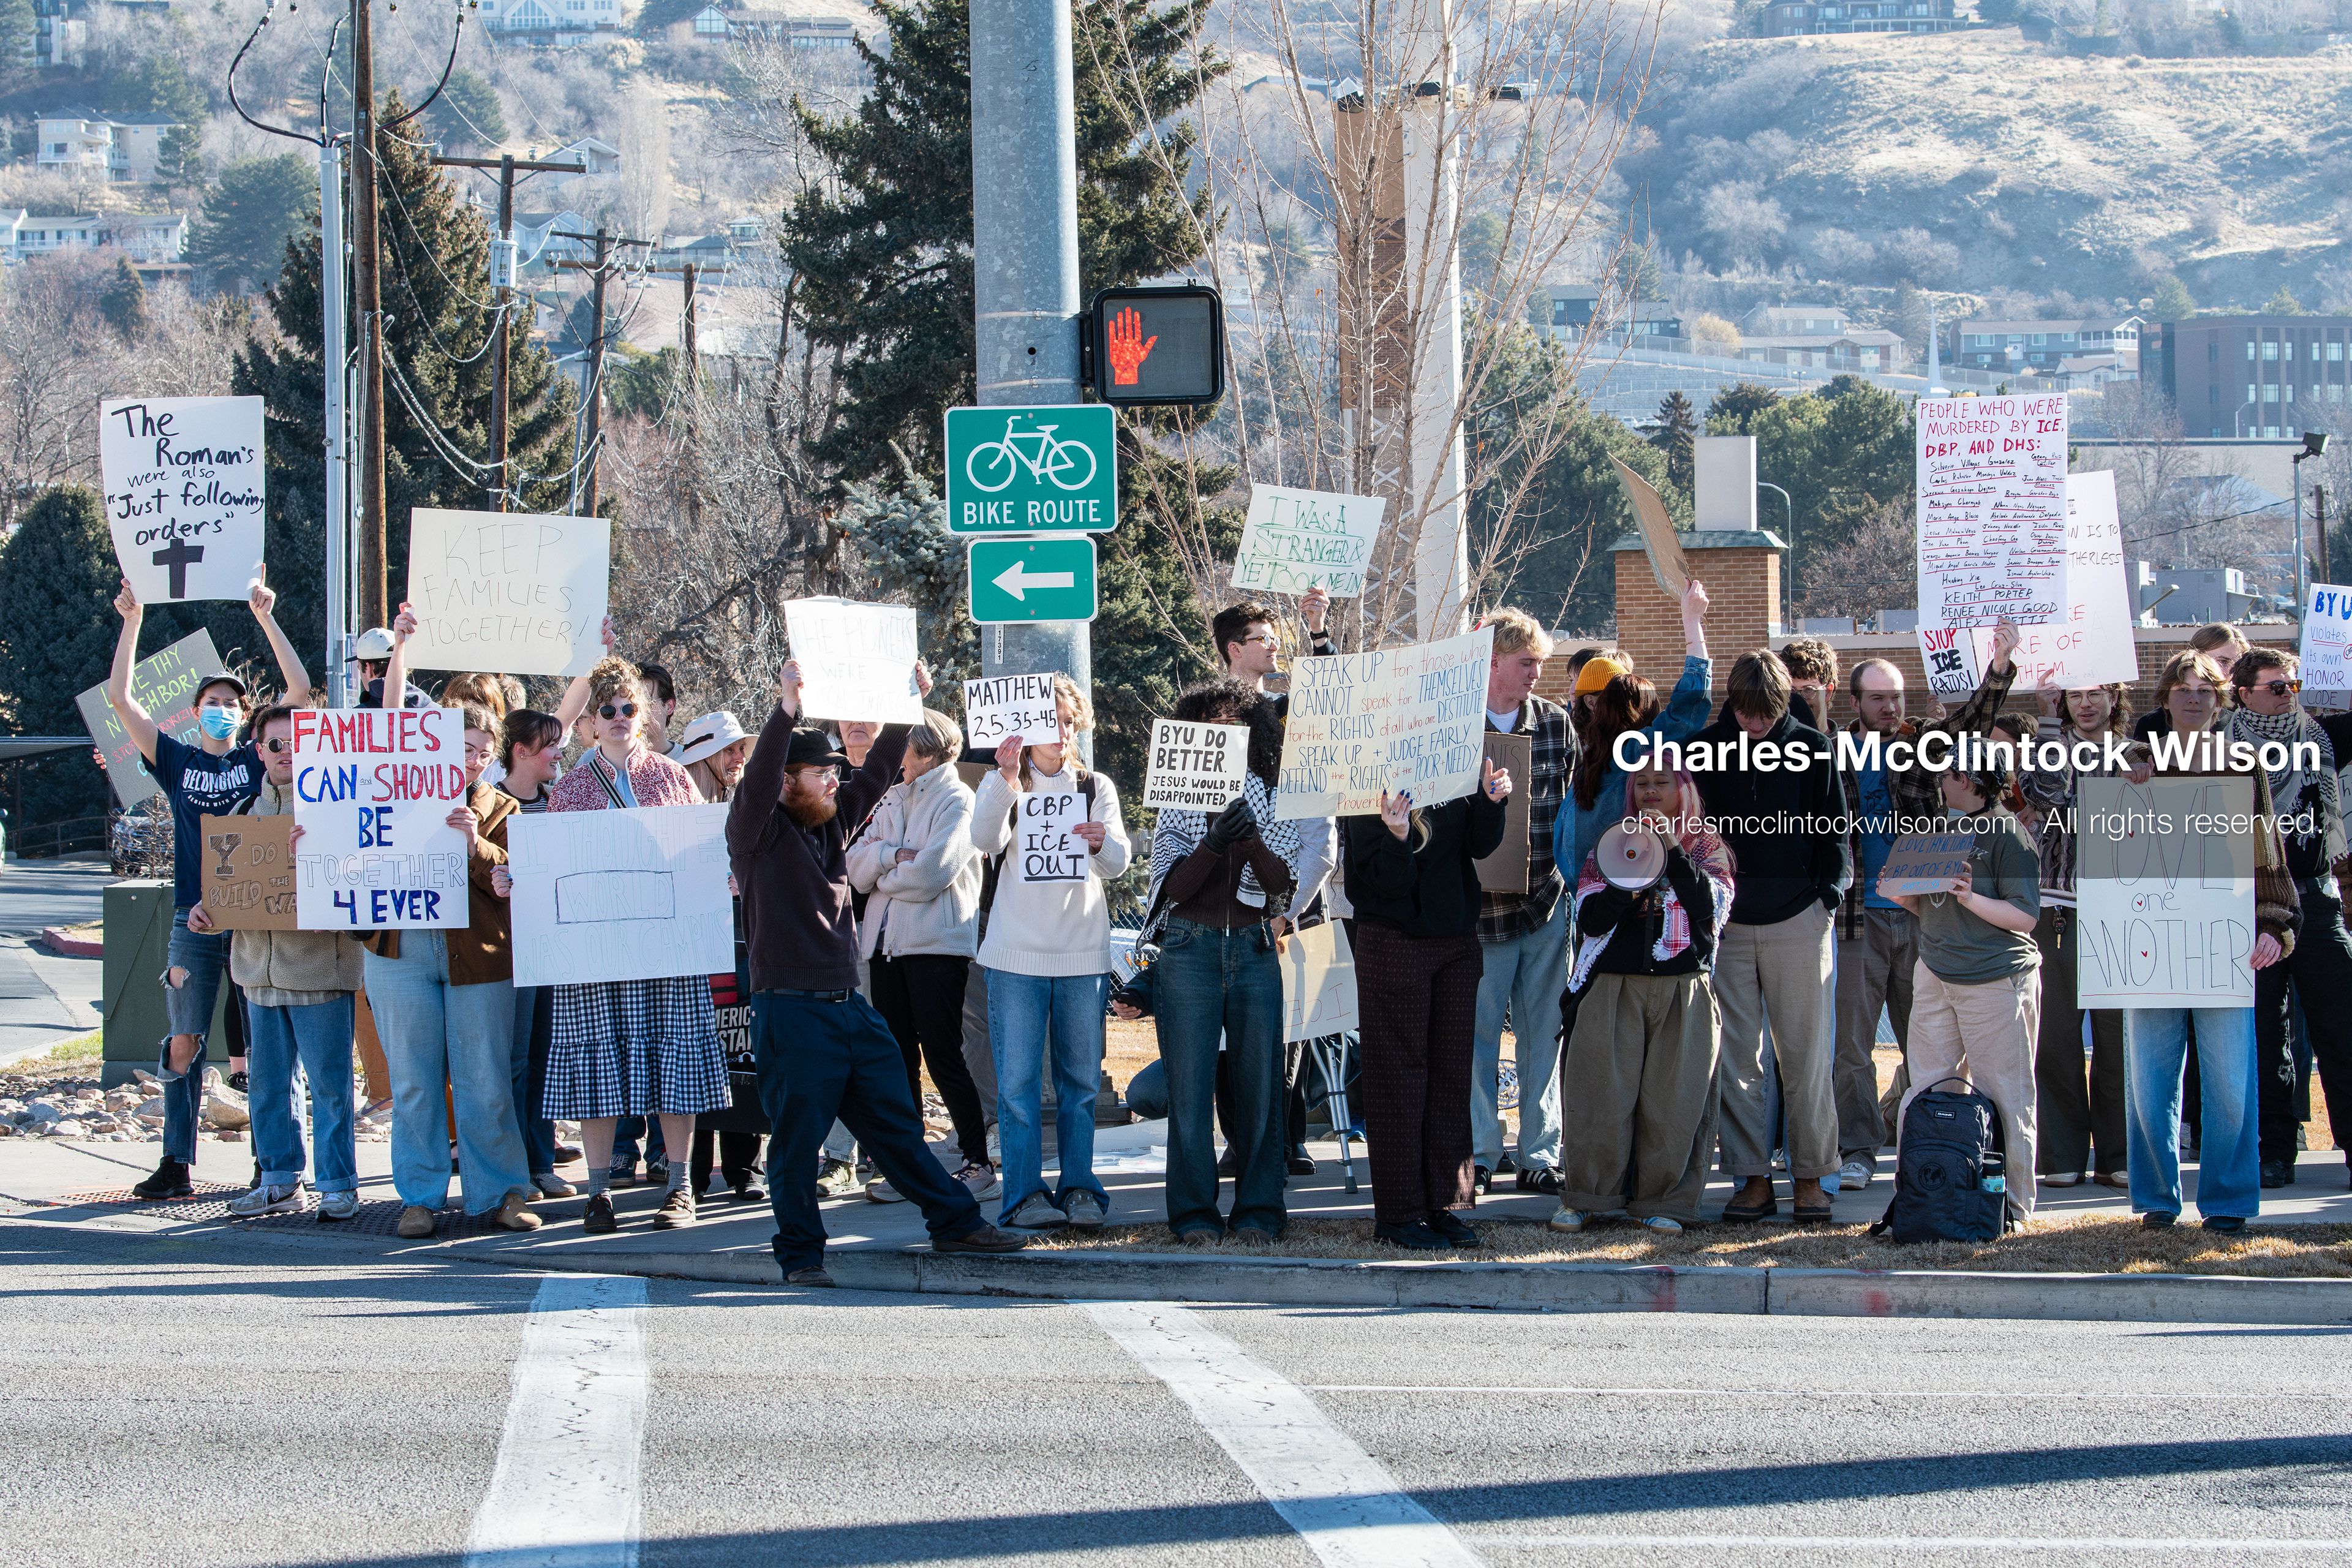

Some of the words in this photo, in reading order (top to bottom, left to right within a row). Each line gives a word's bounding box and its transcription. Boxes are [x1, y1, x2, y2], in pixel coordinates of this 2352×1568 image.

[111, 404, 179, 437] The
[1921, 401, 1969, 419] PEOPLE
[1978, 400, 2015, 417] WHO
[2024, 398, 2064, 416] WERE
[1926, 420, 2000, 439] MURDERED
[2009, 419, 2029, 433] BY
[2036, 418, 2064, 433] ICE,
[156, 437, 255, 468] Roman's
[1969, 439, 1994, 455] AND
[2003, 437, 2041, 452] DHS:
[127, 470, 171, 488] were
[182, 466, 215, 480] also
[107, 488, 170, 519] "Just
[182, 480, 265, 514] following
[963, 502, 1016, 524] BIKE
[1027, 499, 1101, 523] ROUTE
[1261, 496, 1288, 526] I
[135, 511, 235, 546] orders"
[2086, 525, 2101, 538] IS
[2108, 524, 2119, 537] TO
[444, 524, 563, 577] KEEP
[1253, 528, 1349, 564] STRANGER
[1262, 561, 1324, 592] TOOK
[1325, 572, 1346, 592] ME
[1344, 572, 1364, 593] IN
[423, 575, 574, 612] FAMILIES
[1944, 592, 1981, 603] KEITH
[1994, 588, 2034, 600] PORTER
[2314, 590, 2352, 620] BYU
[1941, 606, 1976, 618] RENEE
[1981, 603, 2016, 616] NICOLE
[2022, 601, 2058, 613] GOOD
[1947, 617, 1983, 629] ALEX
[423, 614, 589, 646] TOGETHER!
[787, 615, 834, 654] THE
[2057, 631, 2083, 650] OF
[148, 644, 182, 677] THY
[820, 660, 867, 680] WERE
[1301, 656, 1355, 688] SPEAK
[1362, 651, 1384, 682] UP
[1392, 650, 1413, 679] for
[1420, 647, 1455, 674] those
[1461, 638, 1487, 664] who
[1930, 649, 1963, 674] ICE
[2305, 648, 2316, 663] its
[2321, 653, 2342, 666] own
[1930, 669, 1975, 696] RAIDS!
[2016, 661, 2070, 684] THEM.
[2305, 668, 2346, 688] HONOR
[968, 676, 1052, 710] MATTHEW
[1292, 685, 1354, 718] CANNOT
[1361, 692, 1392, 714] speak
[1397, 687, 1412, 706] for
[1419, 658, 1484, 704] THEMSELVES
[2306, 687, 2339, 706] CODE
[1287, 722, 1305, 742] for
[1306, 723, 1324, 741] the
[1330, 713, 1374, 741] RIGHTS
[1380, 717, 1392, 737] of
[1391, 714, 1403, 734] all
[1408, 718, 1423, 730] who
[1425, 714, 1436, 724] are
[1438, 688, 1484, 724] DESTITUTE
[293, 710, 442, 753] FAMILIES
[1159, 725, 1197, 748] BYU,
[1204, 729, 1226, 748] DO
[1298, 745, 1338, 767] SPEAK
[1344, 744, 1362, 766] UP
[1386, 735, 1423, 763] JUDGE
[1430, 722, 1472, 752] FAIRLY
[1156, 747, 1227, 774] BETTER.
[1280, 766, 1327, 794] DEFEND
[1349, 764, 1392, 790] RIGHTS
[1392, 766, 1400, 778] of
[1401, 766, 1412, 776] the
[1414, 756, 1440, 783] POOR
[1444, 742, 1481, 775] NEEDY
[183, 764, 249, 793] BELONGING
[298, 764, 357, 802] CAN
[360, 777, 372, 785] and
[372, 763, 466, 801] SHOULD
[1152, 776, 1187, 788] JESUS
[1192, 778, 1226, 790] WOULD
[1229, 780, 1241, 791] BE
[187, 794, 209, 807] BEGINS
[213, 798, 229, 807] WITH
[232, 790, 240, 799] US
[1026, 795, 1072, 817] CBP
[1149, 790, 1226, 807] DISAPPOINTED.
[358, 806, 393, 848] BE
[561, 806, 695, 873] THOUGHT
[2081, 782, 2234, 891] LOVE
[251, 842, 277, 867] DO
[1025, 834, 1070, 852] ICE
[1897, 838, 1929, 853] LOVE
[1925, 837, 1943, 853] THY
[298, 852, 465, 888] TOGETHER
[1025, 854, 1084, 876] OUT
[1884, 864, 1909, 882] CBP
[1909, 862, 1930, 877] OUT
[1927, 861, 1945, 876] OF
[1943, 860, 1964, 875] BYU
[209, 880, 263, 910] BUILD
[269, 875, 289, 887] THE
[334, 889, 358, 924] 4
[372, 889, 441, 924] EVER
[562, 871, 672, 922] WORLD
[2131, 892, 2181, 913] one
[513, 929, 575, 984] WAS
[585, 922, 638, 976] OUR
[639, 908, 733, 974] CAMPUS
[2078, 918, 2253, 991] ANOTHER
